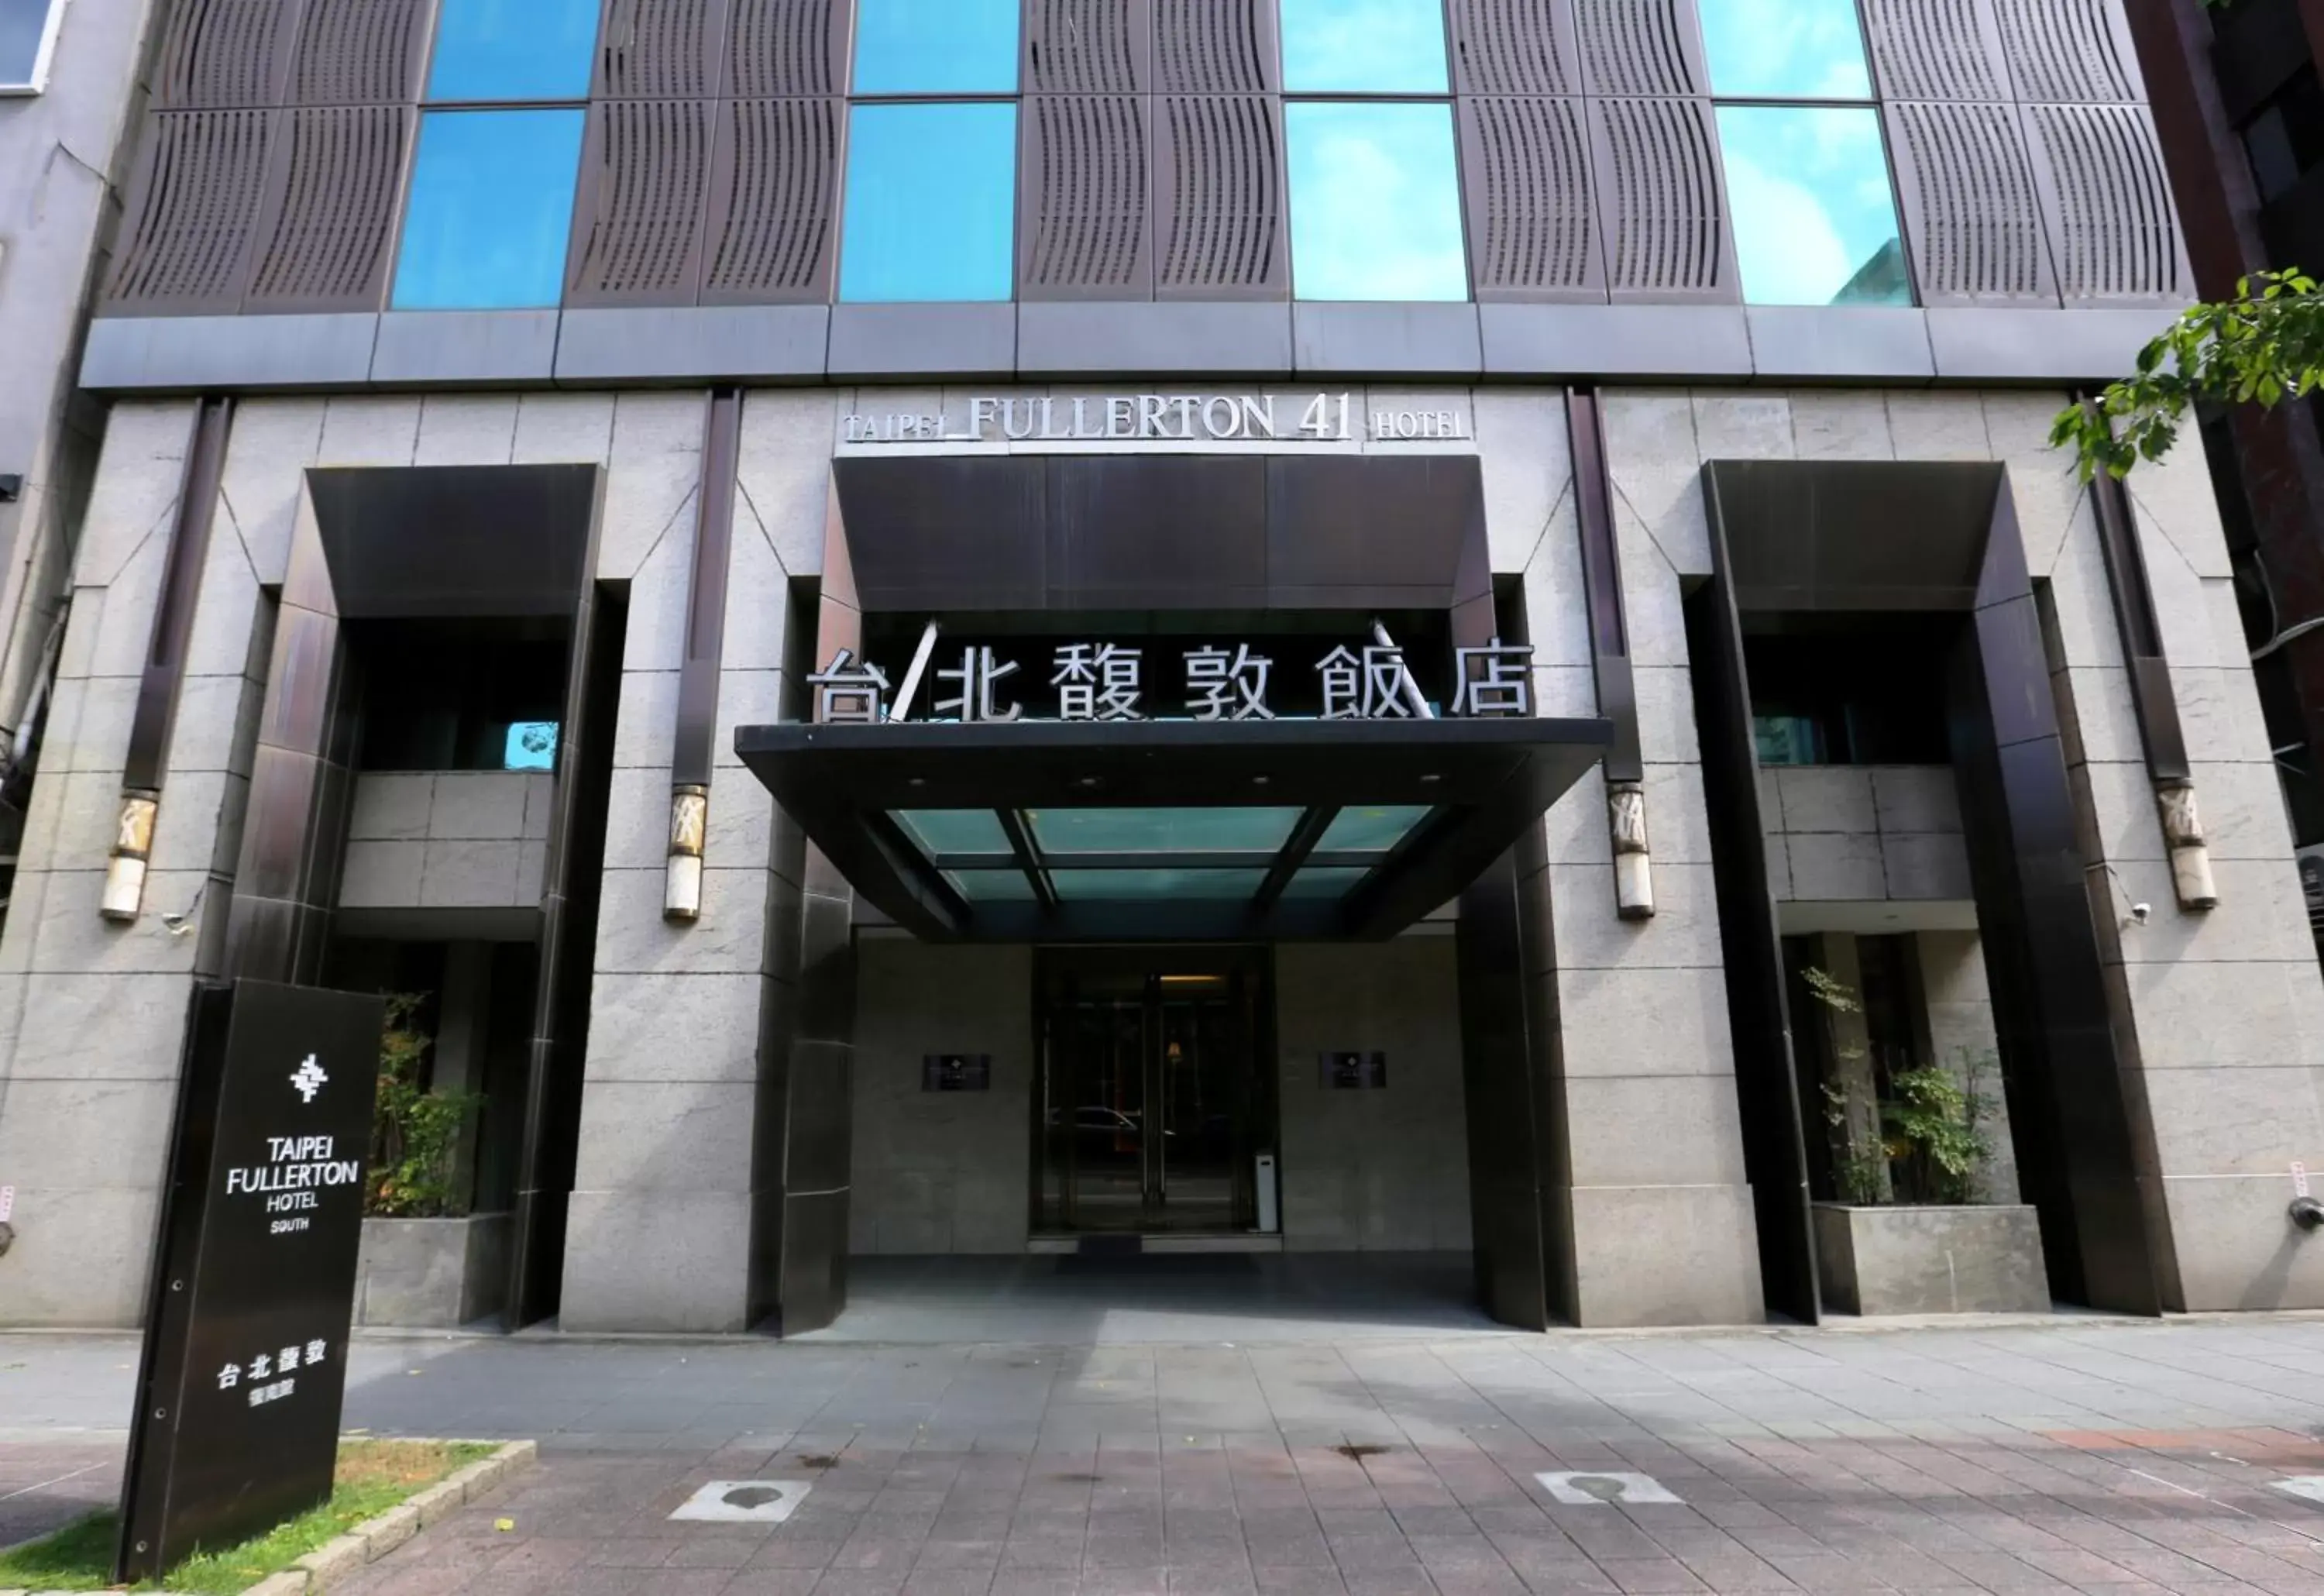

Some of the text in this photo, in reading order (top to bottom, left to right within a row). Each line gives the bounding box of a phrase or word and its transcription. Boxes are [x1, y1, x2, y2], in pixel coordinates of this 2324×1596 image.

[844, 392, 1466, 440] TAIPEI FULLERTON 41 HOTEL
[806, 637, 1535, 723] 台北馥敦飯店
[266, 1136, 333, 1162] TAIPEI
[226, 1160, 359, 1195] FULLERTON
[266, 1192, 319, 1213] HOTEL
[270, 1216, 310, 1234] SOUTH
